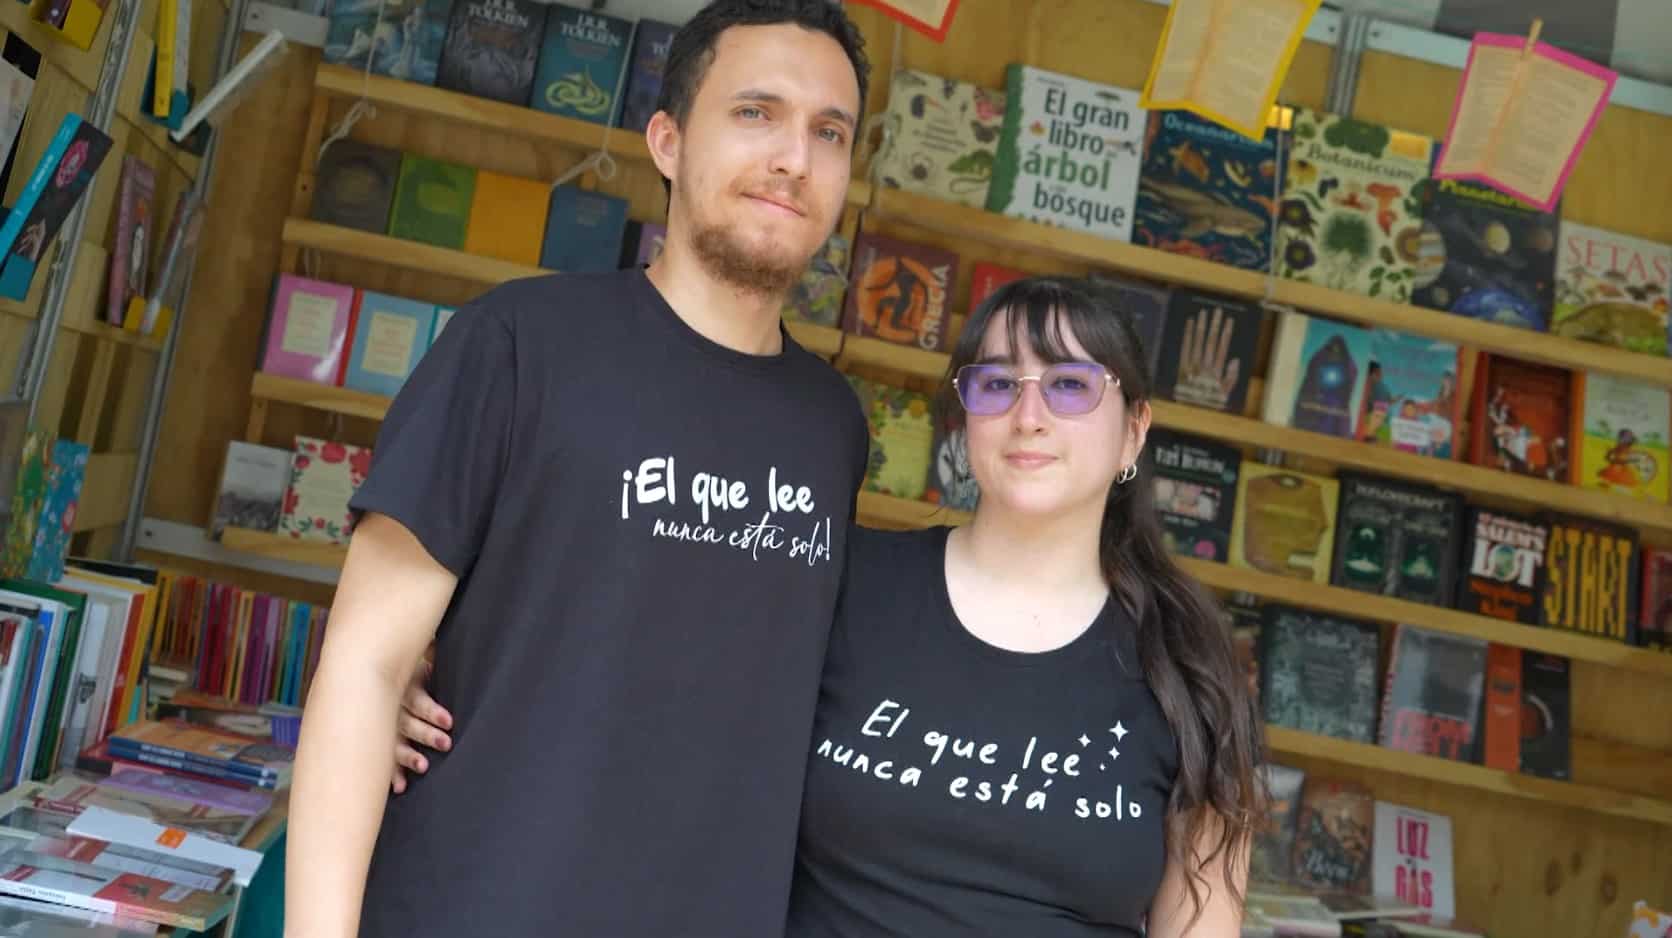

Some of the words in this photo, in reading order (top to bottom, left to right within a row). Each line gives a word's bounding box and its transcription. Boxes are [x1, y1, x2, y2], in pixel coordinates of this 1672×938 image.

[1045, 87, 1067, 117] El
[1072, 101, 1129, 132] gran
[1048, 119, 1105, 156] libro
[1023, 143, 1111, 191] árbol
[1033, 182, 1126, 228] bosque
[1567, 236, 1669, 284] SETAS
[919, 264, 951, 350] GRECIA
[621, 456, 676, 520] ¡El
[691, 471, 750, 525] que
[768, 466, 815, 514] lee
[652, 518, 724, 543] nunca
[788, 516, 831, 567] solo!
[1471, 537, 1544, 588] LOT
[1543, 526, 1633, 640] START
[861, 699, 910, 738] El
[923, 730, 999, 765] que
[1022, 736, 1081, 777] lee
[817, 738, 923, 787] nunca
[949, 773, 1053, 811] está
[1074, 784, 1143, 821] solo
[1395, 815, 1431, 862] LUZ
